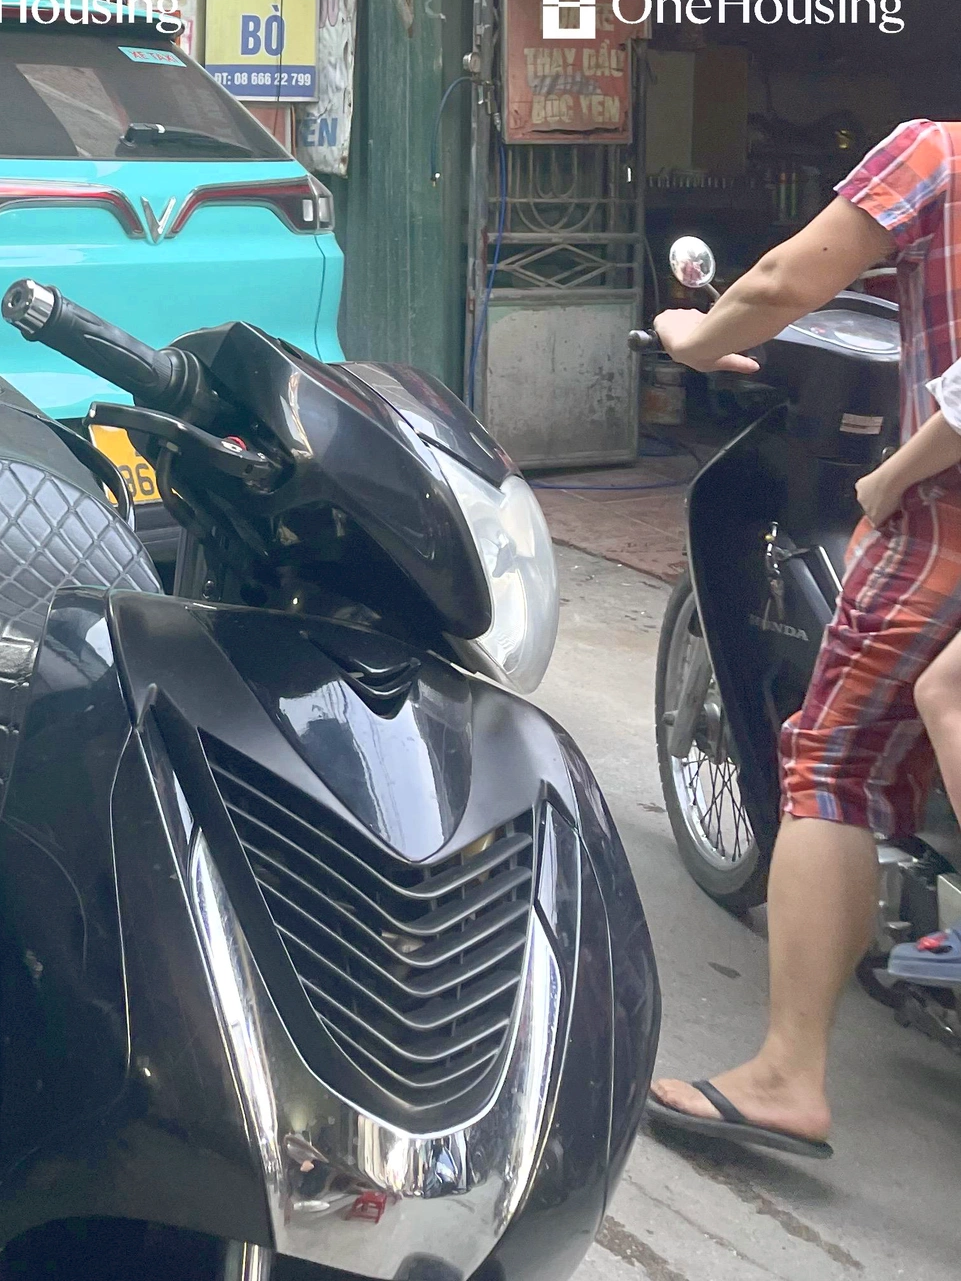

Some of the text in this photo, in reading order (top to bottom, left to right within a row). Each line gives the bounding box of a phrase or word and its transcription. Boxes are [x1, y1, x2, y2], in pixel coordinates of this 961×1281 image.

[240, 5, 285, 56] BÒ
[234, 72, 248, 85] 08
[251, 72, 272, 85] 666
[273, 73, 288, 85] 22
[291, 73, 311, 86] 799
